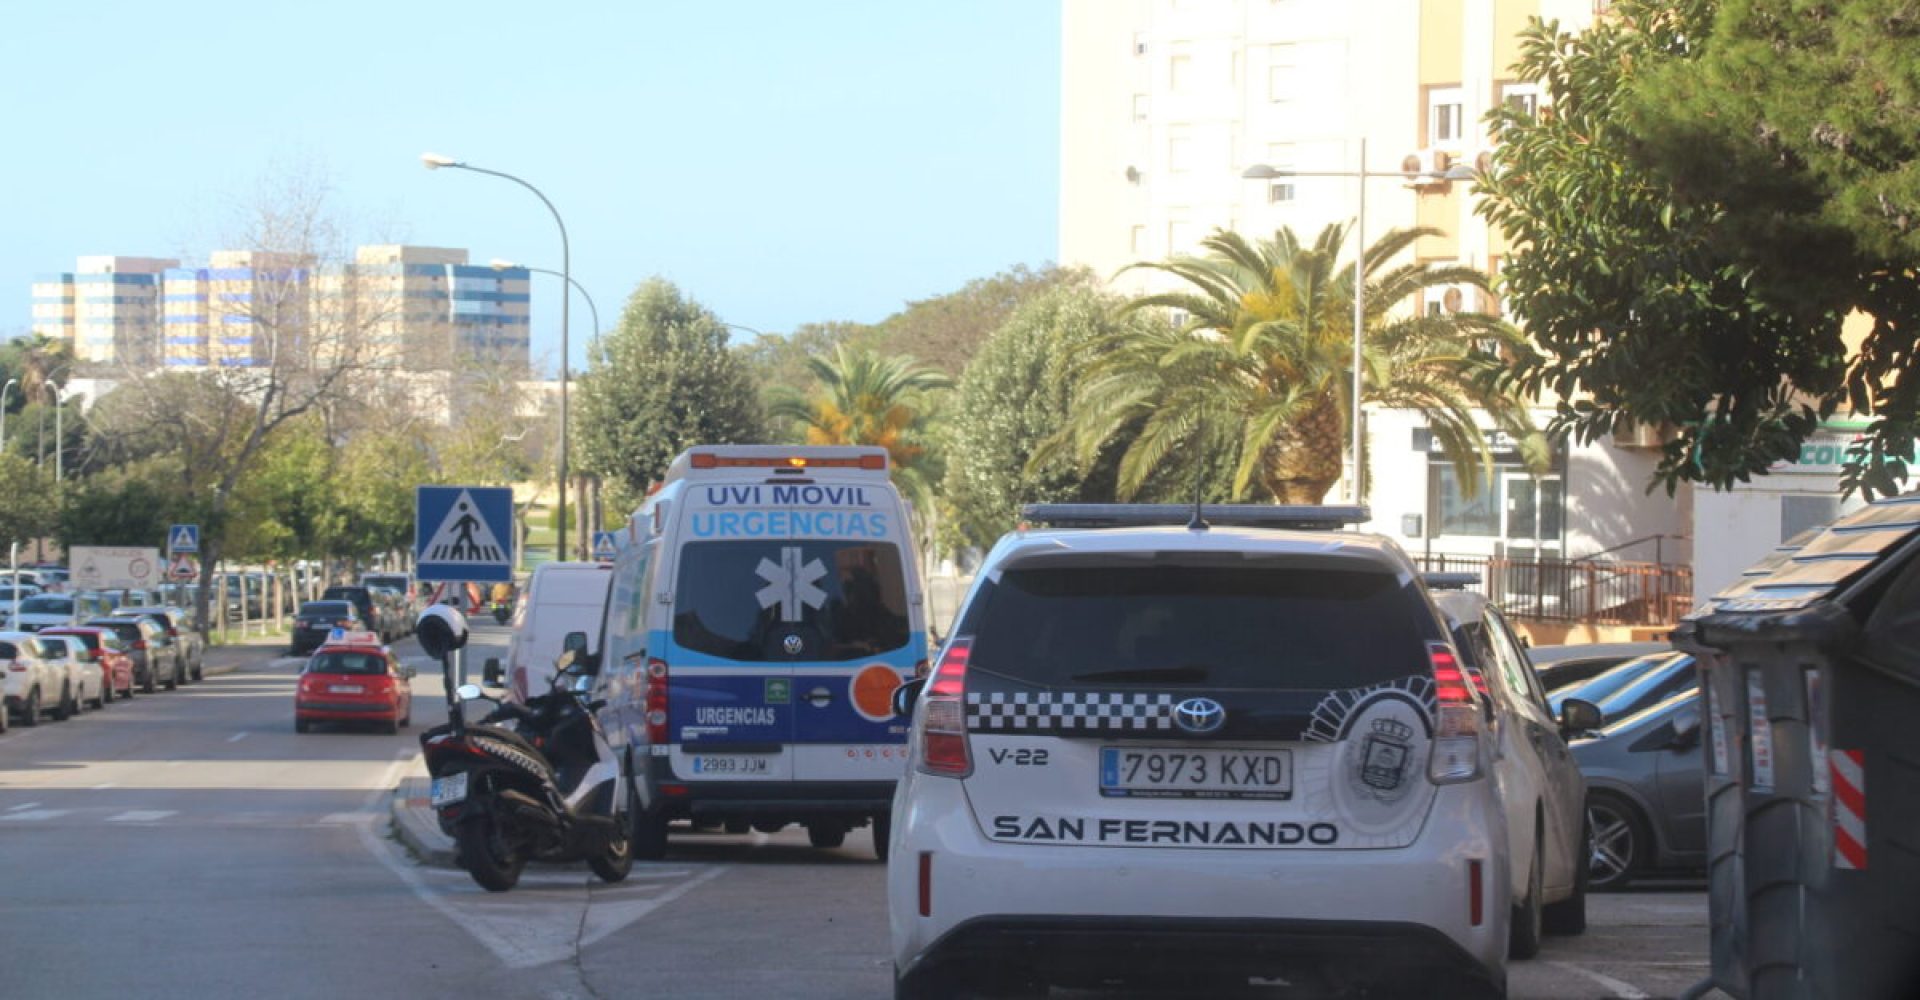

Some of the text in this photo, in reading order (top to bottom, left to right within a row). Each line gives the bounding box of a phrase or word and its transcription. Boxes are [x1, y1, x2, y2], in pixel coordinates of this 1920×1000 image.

[708, 485, 871, 505] UVI MOVIL
[692, 511, 887, 537] URGENCIAS
[696, 706, 775, 725] URGENCIAS
[704, 758, 735, 771] 2993
[989, 747, 1049, 766] V-22
[1125, 753, 1281, 785] 7973 KXD
[994, 815, 1339, 845] SAN FERNANDO
